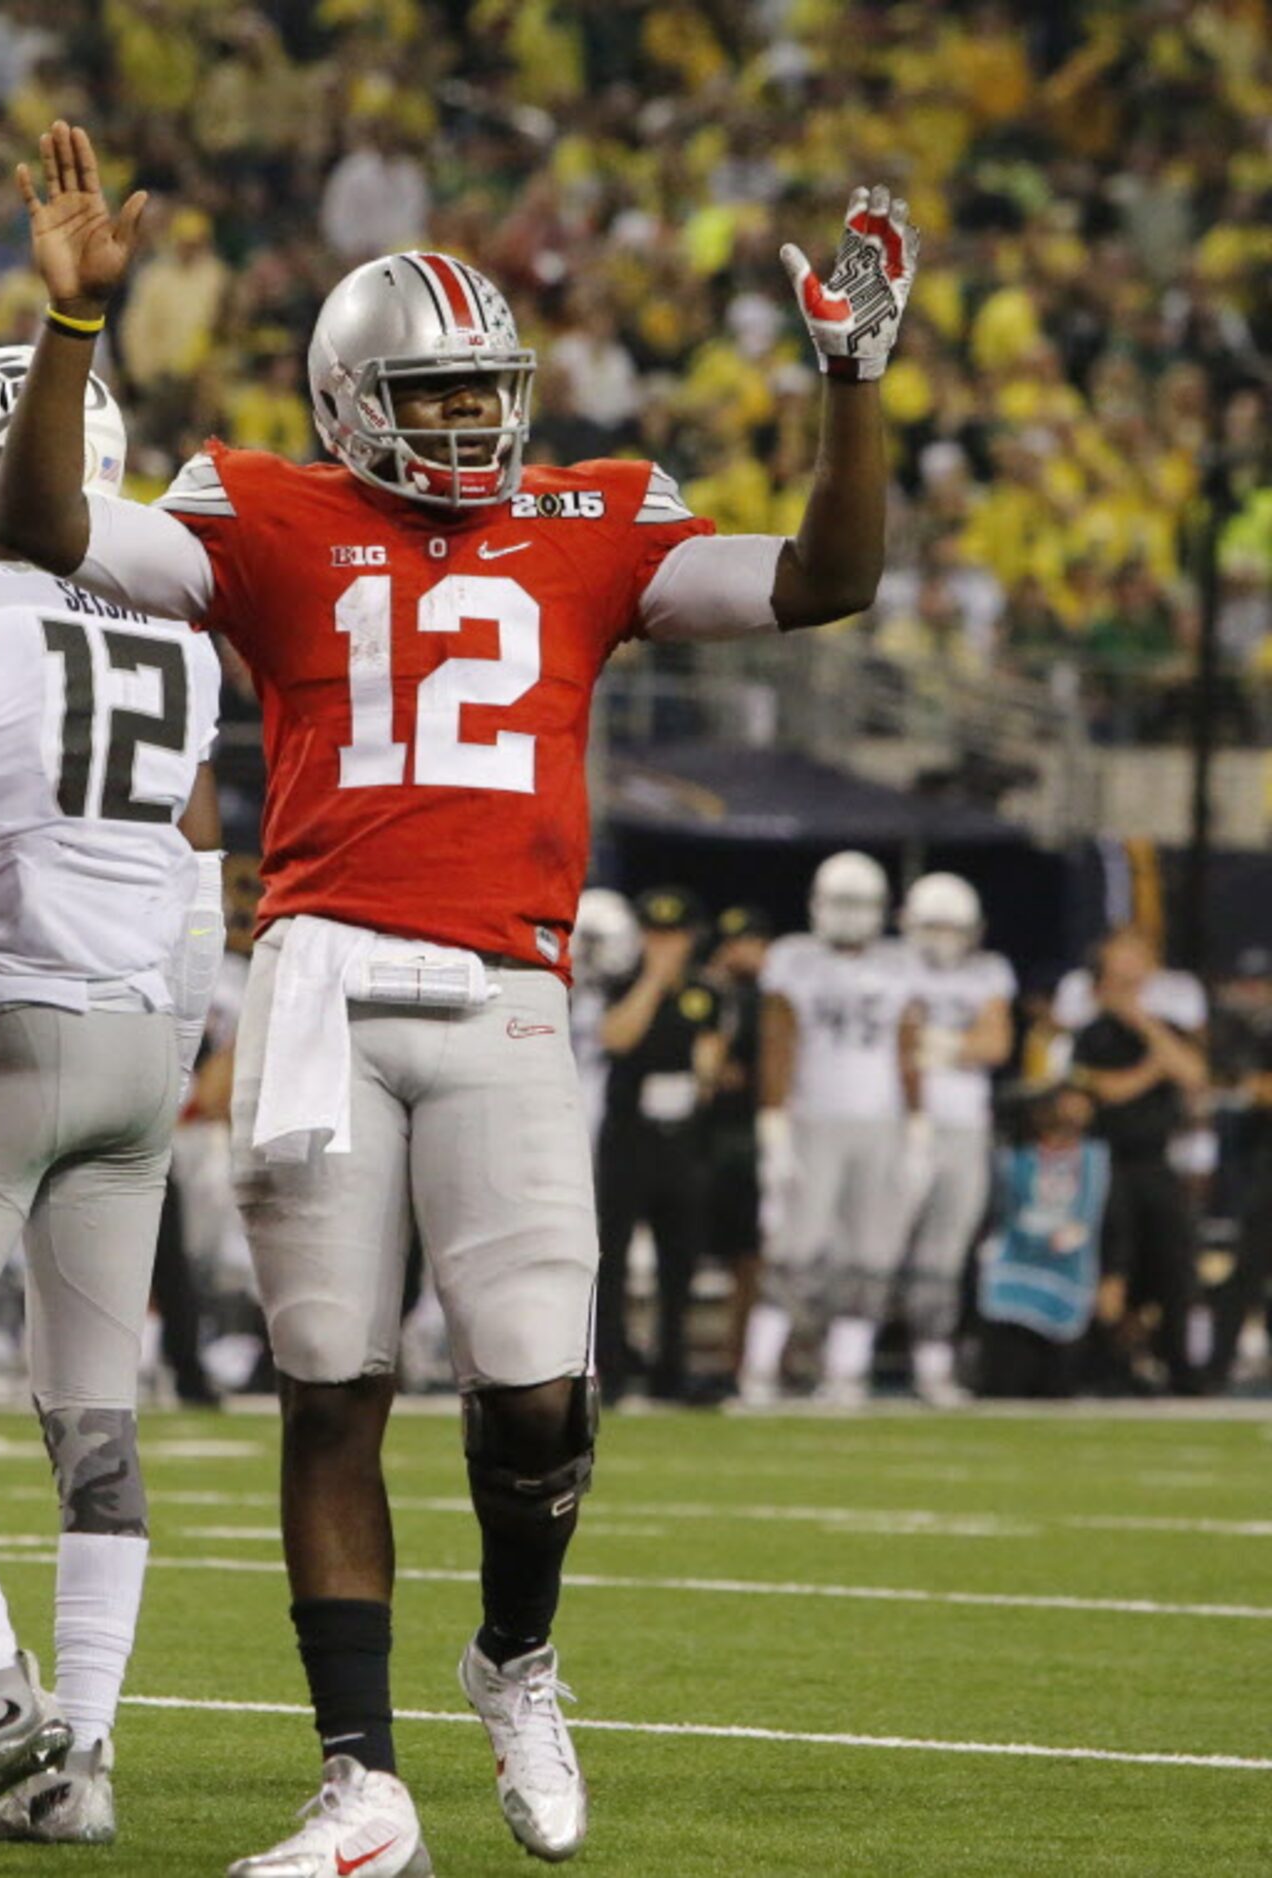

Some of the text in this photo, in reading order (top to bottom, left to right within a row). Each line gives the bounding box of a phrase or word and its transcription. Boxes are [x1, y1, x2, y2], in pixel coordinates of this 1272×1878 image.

[510, 490, 606, 519] 2015
[42, 620, 189, 824] 12
[335, 573, 541, 795] 12
